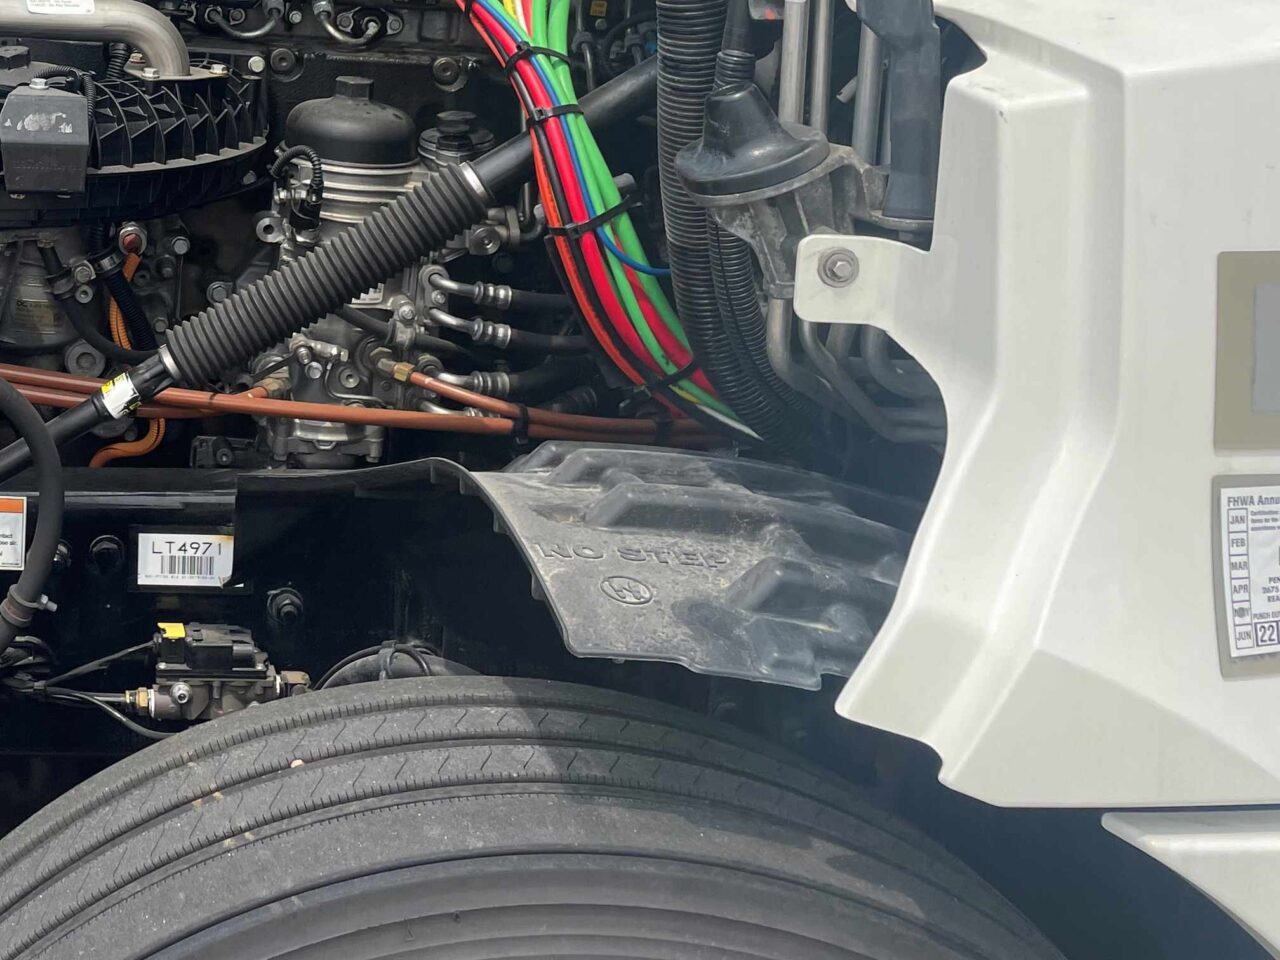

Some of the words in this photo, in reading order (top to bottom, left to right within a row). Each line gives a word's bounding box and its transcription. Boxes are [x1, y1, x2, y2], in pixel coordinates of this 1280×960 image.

[1227, 496, 1255, 507] FHWA
[1230, 515, 1245, 525] JAN
[152, 540, 222, 556] LT4971
[1231, 538, 1246, 548] FEB
[535, 542, 605, 561] NO
[616, 545, 730, 570] STEP
[1231, 561, 1248, 571] MAR
[1233, 584, 1249, 594] APR
[1236, 630, 1252, 641] JUN
[1259, 624, 1276, 643] 22
